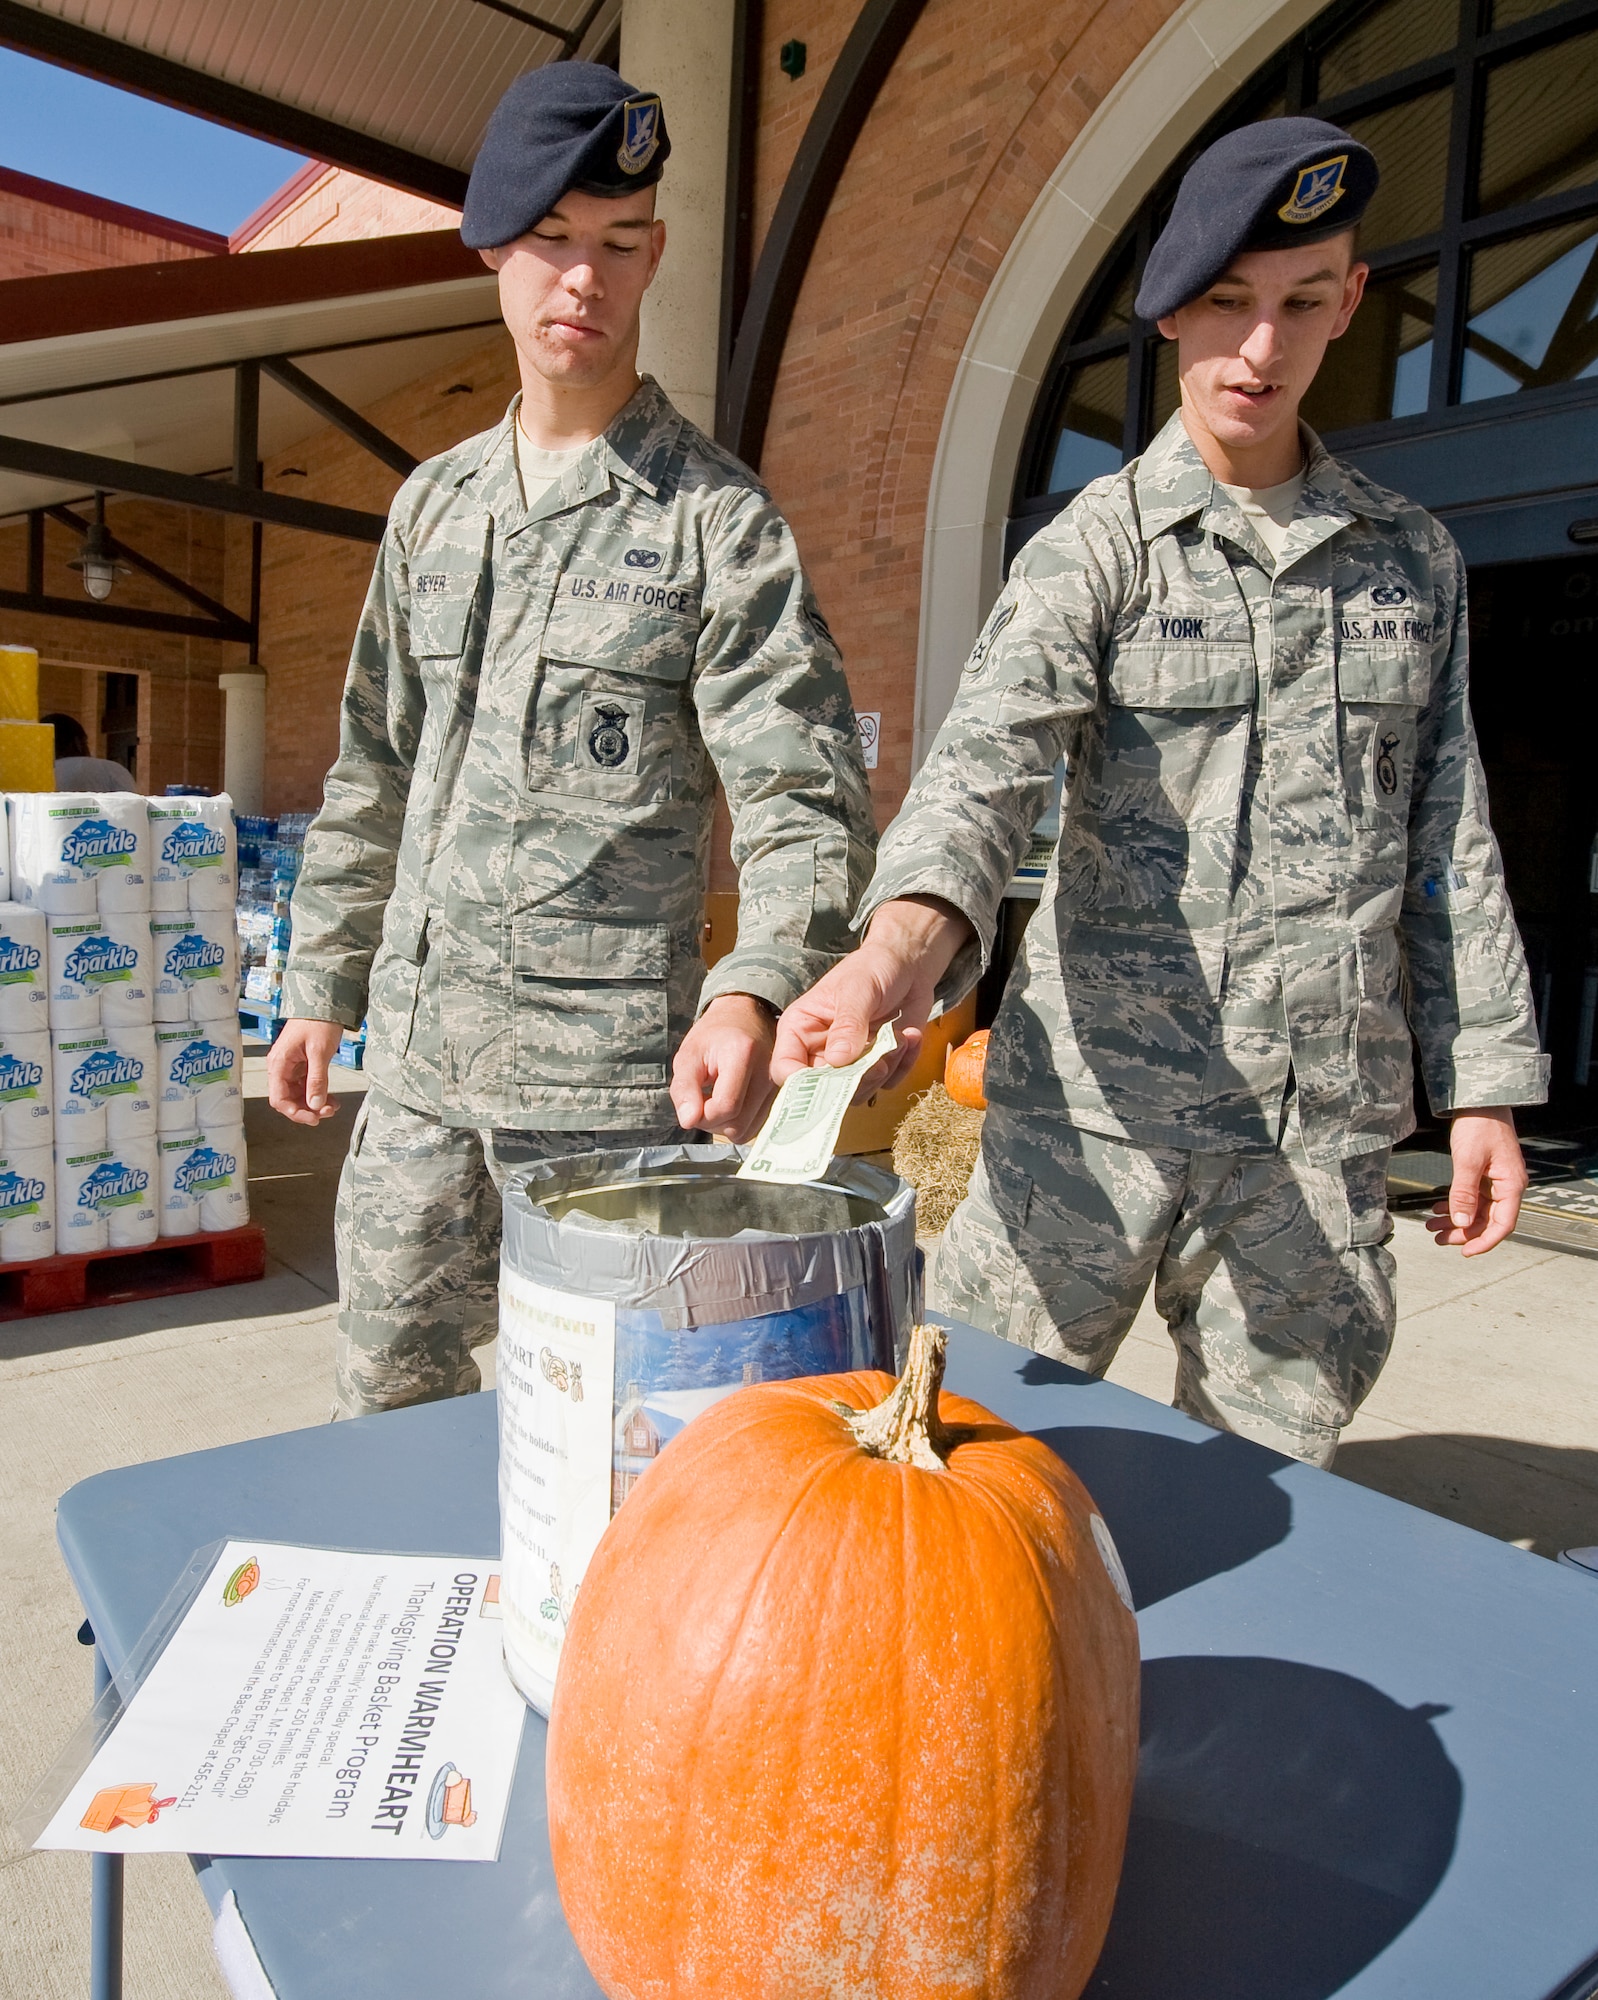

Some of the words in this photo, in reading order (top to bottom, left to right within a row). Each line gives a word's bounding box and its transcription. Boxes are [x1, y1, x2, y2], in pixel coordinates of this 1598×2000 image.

[416, 574, 447, 593] BEYER
[571, 577, 599, 598] U.S.
[605, 582, 628, 602] AIR
[633, 585, 689, 612] FORCE
[1159, 618, 1204, 639] YORK
[1340, 620, 1367, 639] U.S.
[1373, 620, 1397, 639] AIR
[1404, 620, 1433, 643] FORCE
[62, 830, 136, 865] Sparkle
[163, 832, 225, 864] Sparkle
[125, 874, 134, 885] 6
[64, 945, 137, 981] Sparkle
[164, 943, 224, 976] Sparkle
[29, 991, 38, 1003] 6
[126, 989, 135, 1000] 6
[170, 1047, 234, 1084] Sparkle
[70, 1058, 144, 1096] Sparkle
[31, 1106, 40, 1117] 6
[132, 1101, 140, 1112] 6
[174, 1153, 237, 1192] Sparkle
[750, 1159, 773, 1173] 5
[77, 1169, 149, 1209] Sparkle
[138, 1210, 145, 1220] 6
[33, 1222, 41, 1232] 6
[295, 1577, 310, 1591] For
[371, 1574, 388, 1591] Your
[283, 1591, 301, 1612] more
[303, 1590, 324, 1611] Make
[327, 1589, 344, 1602] You
[357, 1591, 381, 1620] financial
[320, 1603, 334, 1616] can
[335, 1613, 352, 1627] Our
[290, 1612, 312, 1637] checks
[312, 1617, 328, 1633] also
[371, 1613, 390, 1630] Help
[376, 1581, 435, 1671] Thanksgiving
[422, 1572, 478, 1674] OPERATION
[259, 1613, 294, 1658] information
[326, 1628, 342, 1645] goal
[341, 1621, 367, 1656] donation
[363, 1631, 380, 1653] make
[273, 1638, 297, 1671] payable
[298, 1634, 322, 1663] donate
[318, 1654, 332, 1664] to
[250, 1660, 266, 1675] call
[292, 1664, 305, 1673] at
[307, 1665, 329, 1684] help
[334, 1658, 349, 1673] can
[241, 1676, 260, 1692] the
[268, 1672, 283, 1682] to
[323, 1674, 346, 1694] help
[278, 1675, 303, 1705] Chapel
[299, 1685, 316, 1706] over
[229, 1693, 252, 1715] Base
[272, 1707, 288, 1715] 1.
[311, 1695, 333, 1725] others
[330, 1694, 357, 1728] holiday
[358, 1675, 401, 1730] Basket
[241, 1713, 263, 1733] First
[263, 1718, 283, 1737] M-F
[290, 1708, 309, 1726] 250
[210, 1716, 239, 1748] Chapel
[230, 1734, 252, 1754] Sgts
[270, 1727, 301, 1768] families.
[294, 1727, 322, 1759] during
[316, 1730, 340, 1768] special.
[203, 1749, 218, 1760] at
[369, 1679, 446, 1836] WARMHEART
[228, 1739, 273, 1802] (0730-1630).
[288, 1761, 307, 1779] the
[324, 1736, 379, 1819] Program
[172, 1761, 214, 1812] 456-2111.
[266, 1781, 300, 1826] holidays.
